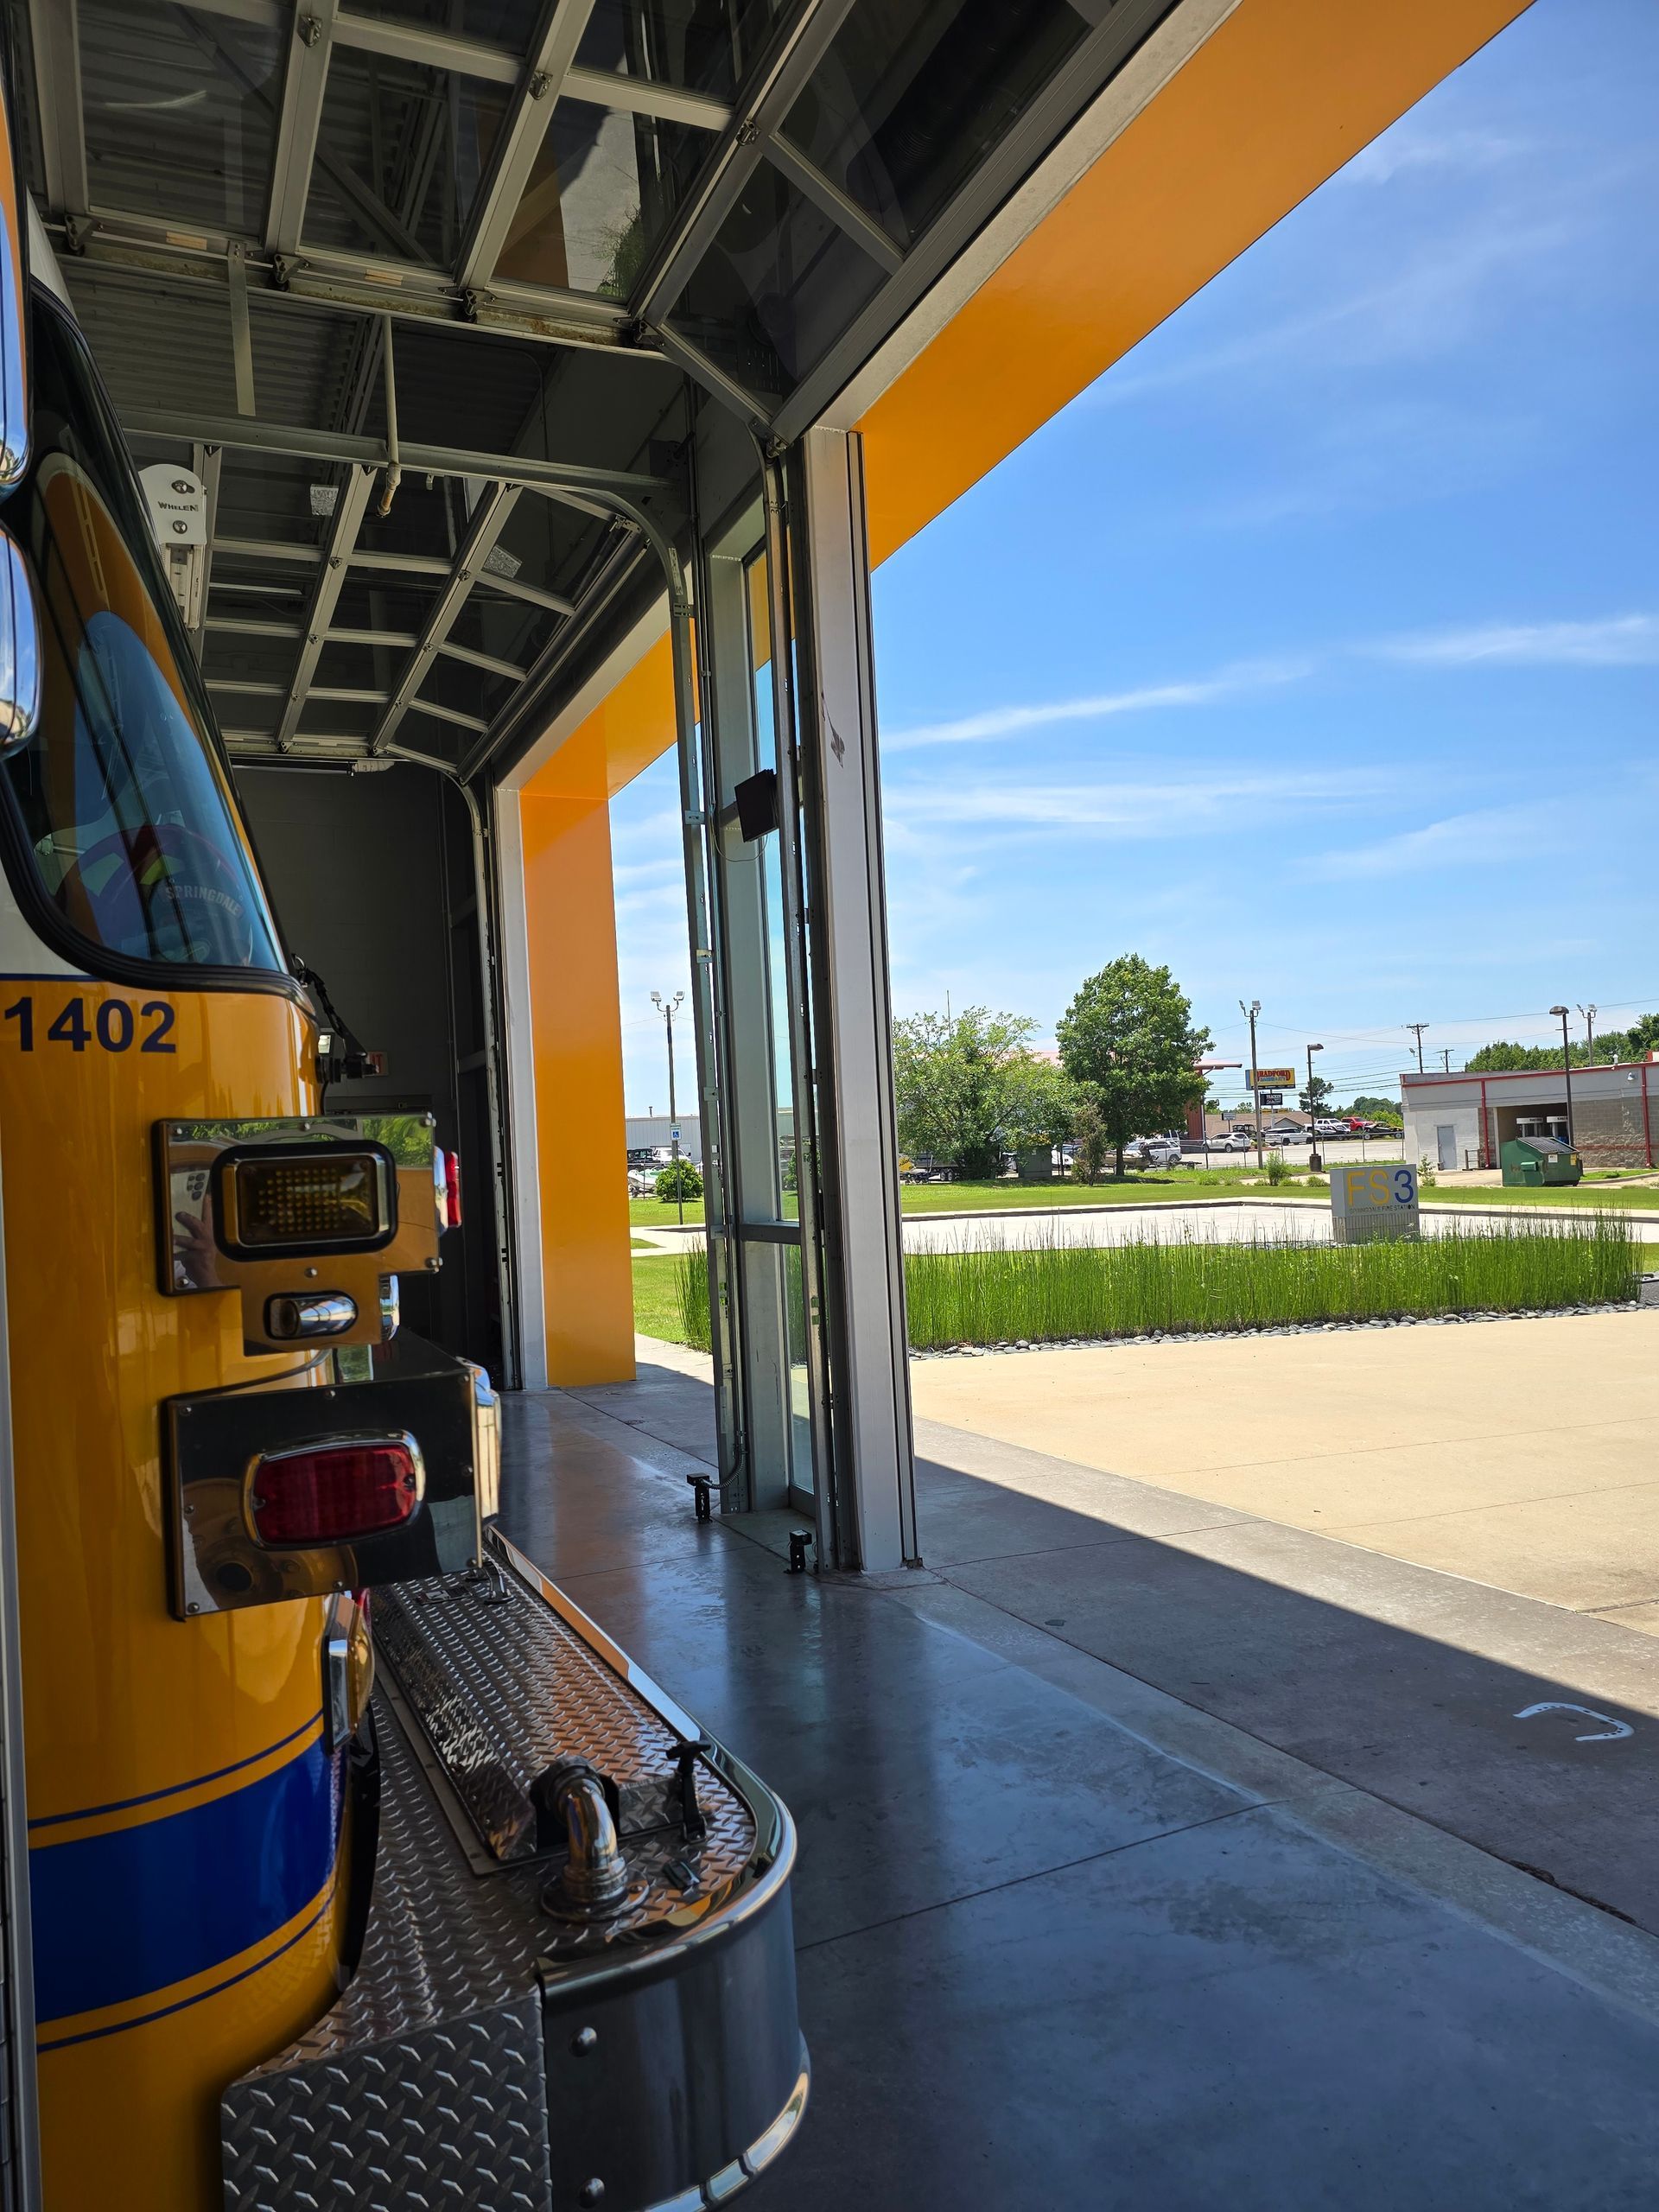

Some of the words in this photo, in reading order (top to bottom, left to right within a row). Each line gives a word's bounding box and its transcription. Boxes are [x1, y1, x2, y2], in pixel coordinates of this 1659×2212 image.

[157, 501, 199, 512] WHELEN
[165, 885, 244, 916] SPRINGDALE
[4, 996, 176, 1053] 1402
[1346, 1169, 1414, 1207] FS3
